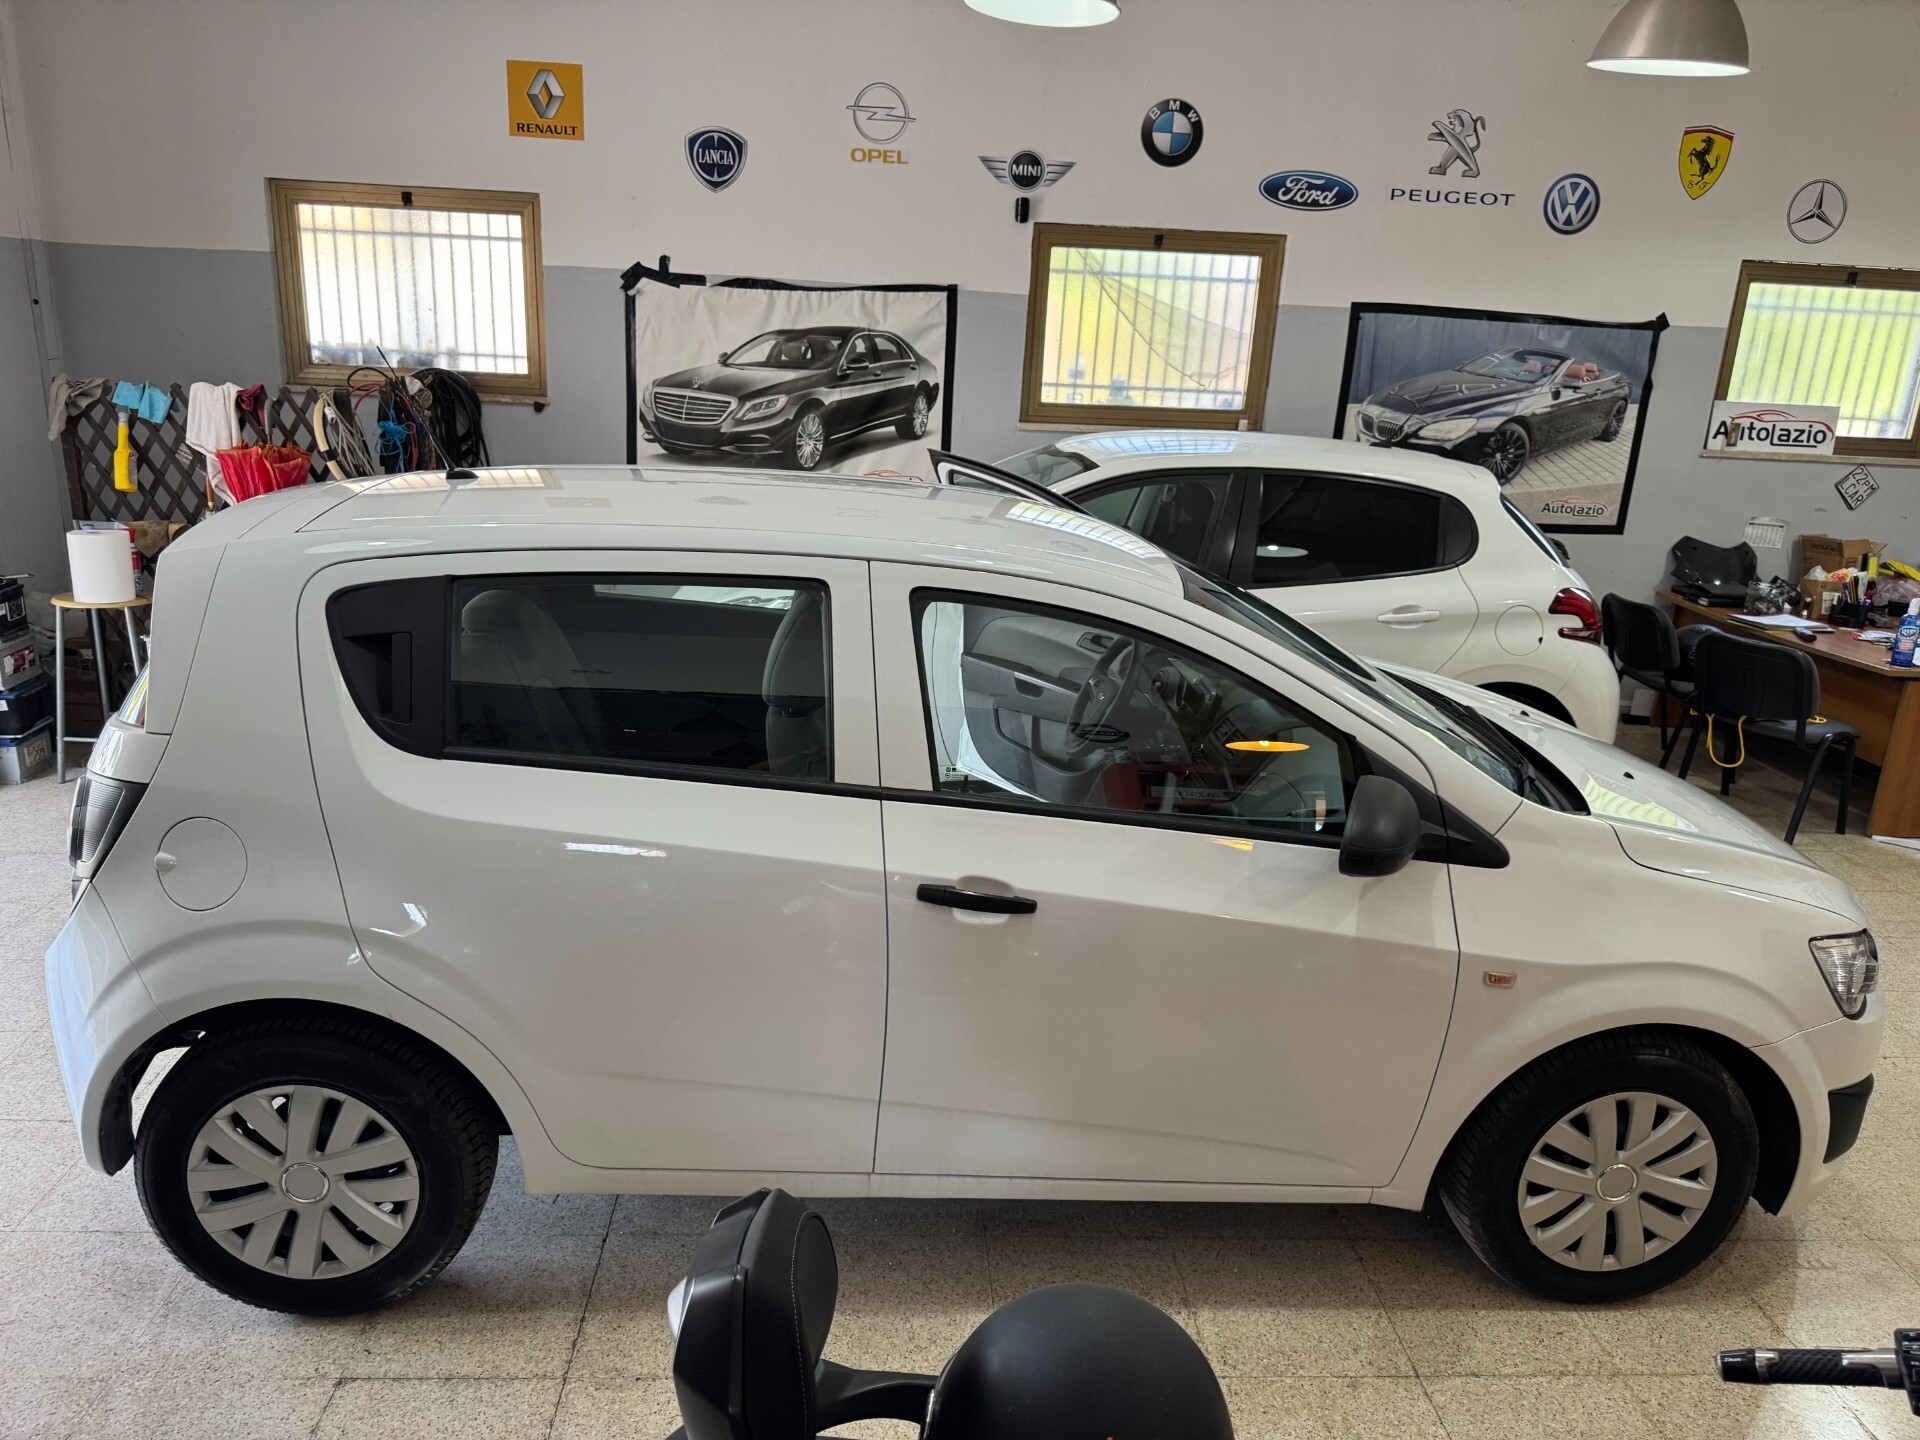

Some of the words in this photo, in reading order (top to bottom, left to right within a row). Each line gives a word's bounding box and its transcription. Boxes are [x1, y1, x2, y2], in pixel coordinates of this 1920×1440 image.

[1148, 99, 1200, 123] BMW
[516, 122, 578, 136] RENAULT
[698, 148, 734, 166] LANCIA
[850, 147, 909, 165] OPEL
[1011, 163, 1042, 177] MINI
[1277, 175, 1340, 206] Ford
[1390, 188, 1516, 207] PEUGEOT
